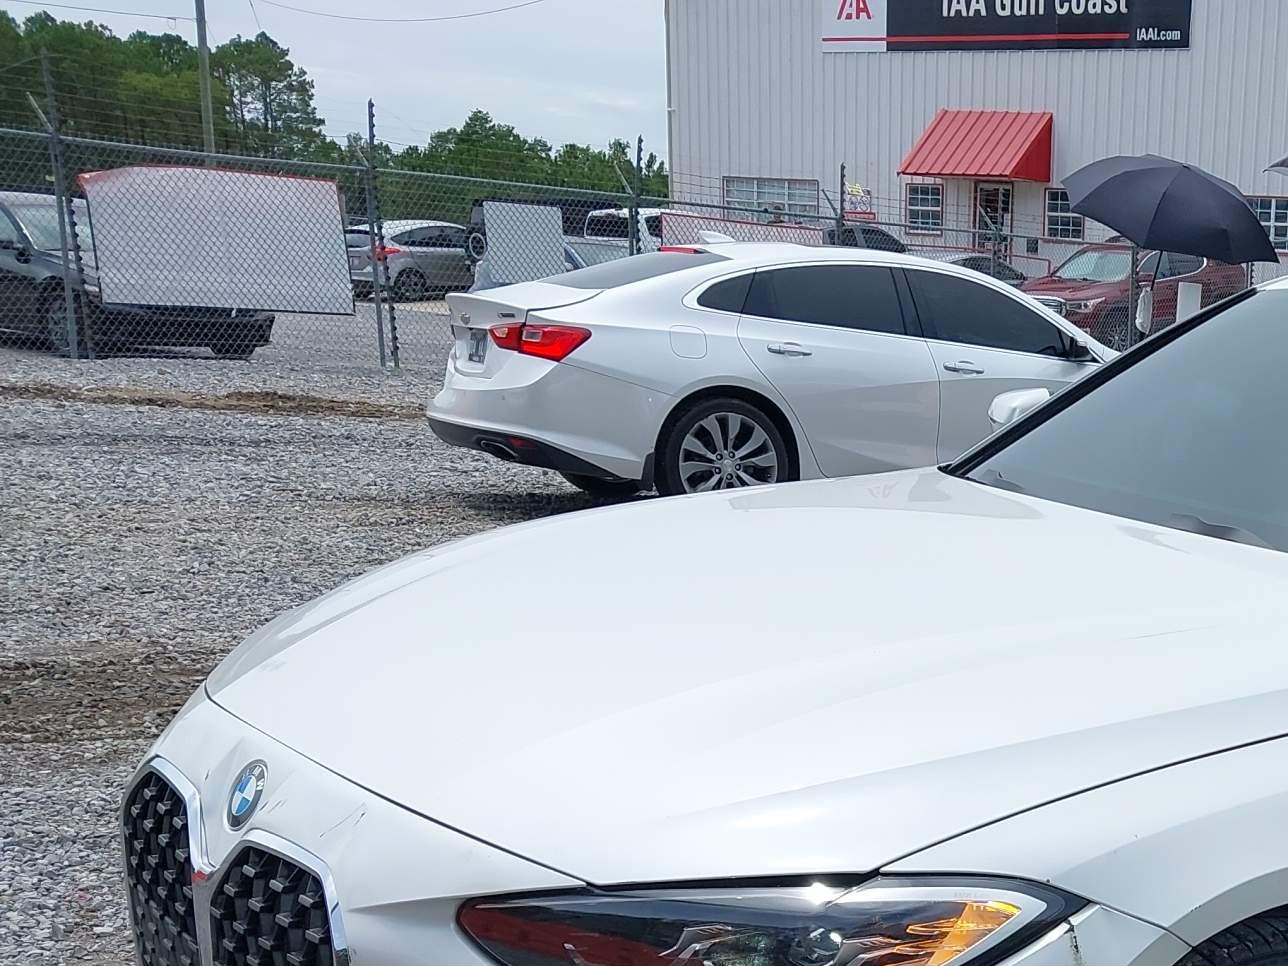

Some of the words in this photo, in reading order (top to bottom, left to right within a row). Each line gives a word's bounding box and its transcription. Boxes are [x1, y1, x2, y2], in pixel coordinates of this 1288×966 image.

[941, 0, 987, 17] IAA
[1054, 0, 1128, 15] Coast
[1136, 27, 1181, 41] IAAI.com
